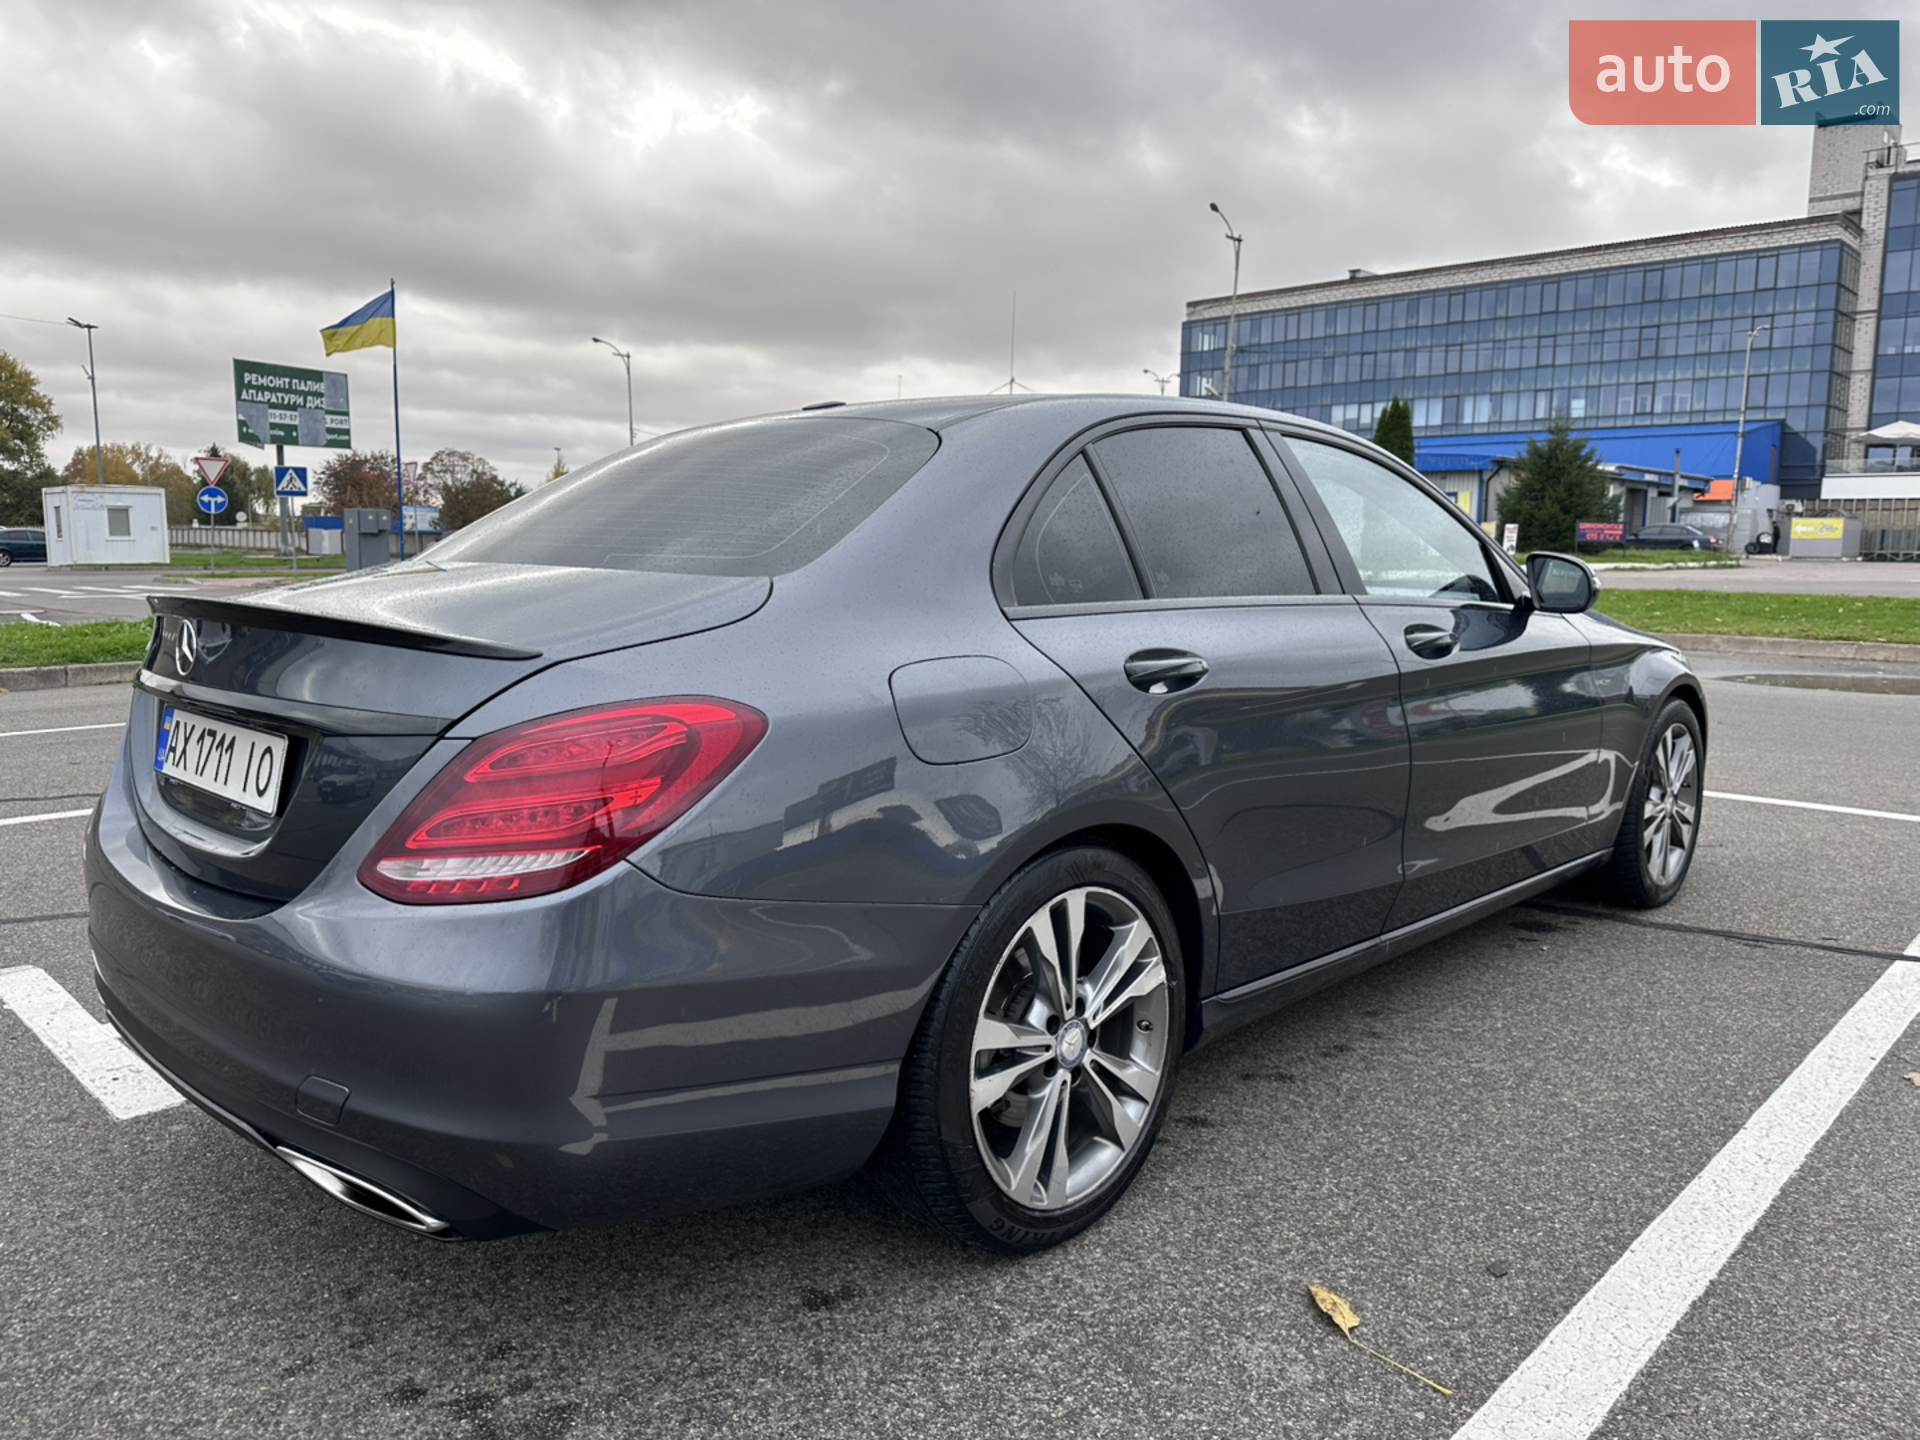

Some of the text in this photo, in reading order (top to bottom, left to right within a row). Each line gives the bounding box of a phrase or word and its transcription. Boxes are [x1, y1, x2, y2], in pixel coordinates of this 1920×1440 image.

[243, 372, 290, 389] РЕМОНТ
[241, 388, 304, 406] АПАРАТУРИ
[330, 417, 348, 426] PORT
[242, 741, 274, 798] IO
